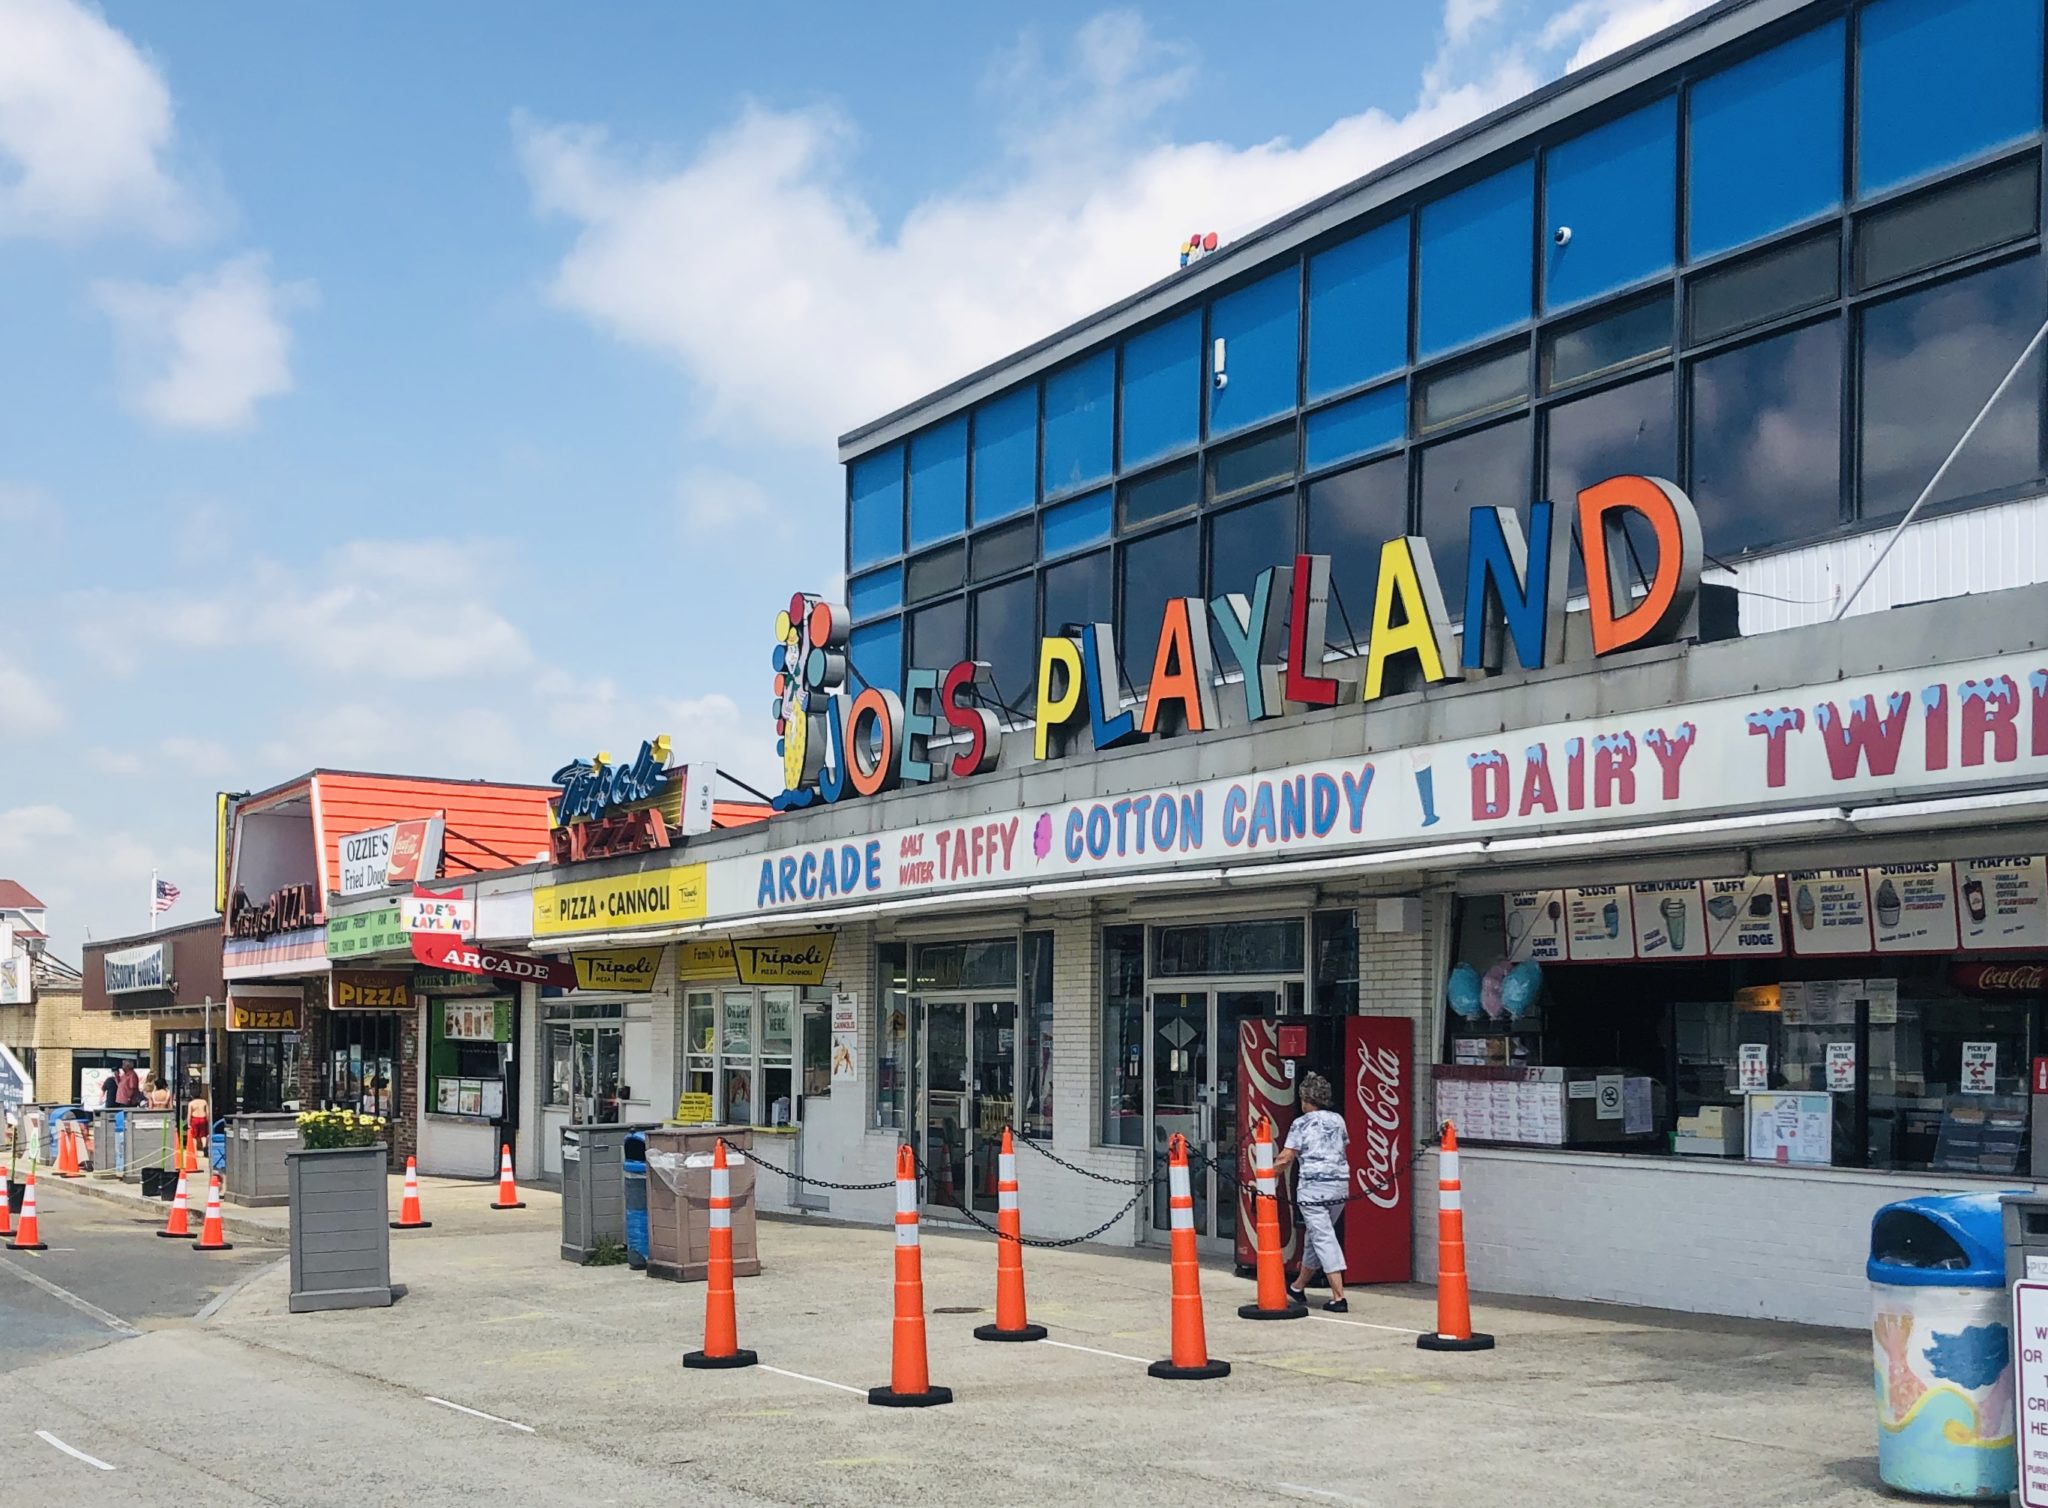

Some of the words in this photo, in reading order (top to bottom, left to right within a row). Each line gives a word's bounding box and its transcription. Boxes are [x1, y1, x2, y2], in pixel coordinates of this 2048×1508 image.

[819, 660, 998, 803] JOES
[1034, 474, 1700, 761] PLAYLAND
[1469, 720, 1696, 822] DAIRY
[1065, 789, 1203, 864] COTTON
[1223, 762, 1376, 848] CANDY
[347, 833, 389, 862] OZZIE'S
[549, 809, 671, 865] PIZZA
[899, 832, 924, 859] SALT
[936, 816, 1020, 881] TAFFY
[344, 869, 363, 891] Fried
[758, 840, 882, 908] ARCADE
[899, 860, 934, 886] WATER
[1712, 880, 1746, 893] TAFFY
[419, 903, 457, 916] JOE'S
[560, 895, 597, 922] PIZZA
[608, 885, 670, 917] CANNOLI
[1513, 897, 1537, 907] CANDY
[1531, 947, 1559, 957] APPLES
[1532, 937, 1556, 947] CANDY
[1738, 933, 1773, 946] FUDGE
[137, 947, 161, 988] HOUSE
[442, 949, 550, 980] ARCADE
[577, 956, 653, 982] Tripoli
[739, 945, 825, 975] Tripoli
[339, 981, 408, 1006] PIZZA
[234, 1007, 295, 1028] PIZZA
[1356, 1037, 1400, 1209] Coca-Cola
[2035, 1326, 2048, 1340] W
[2023, 1349, 2043, 1363] OR
